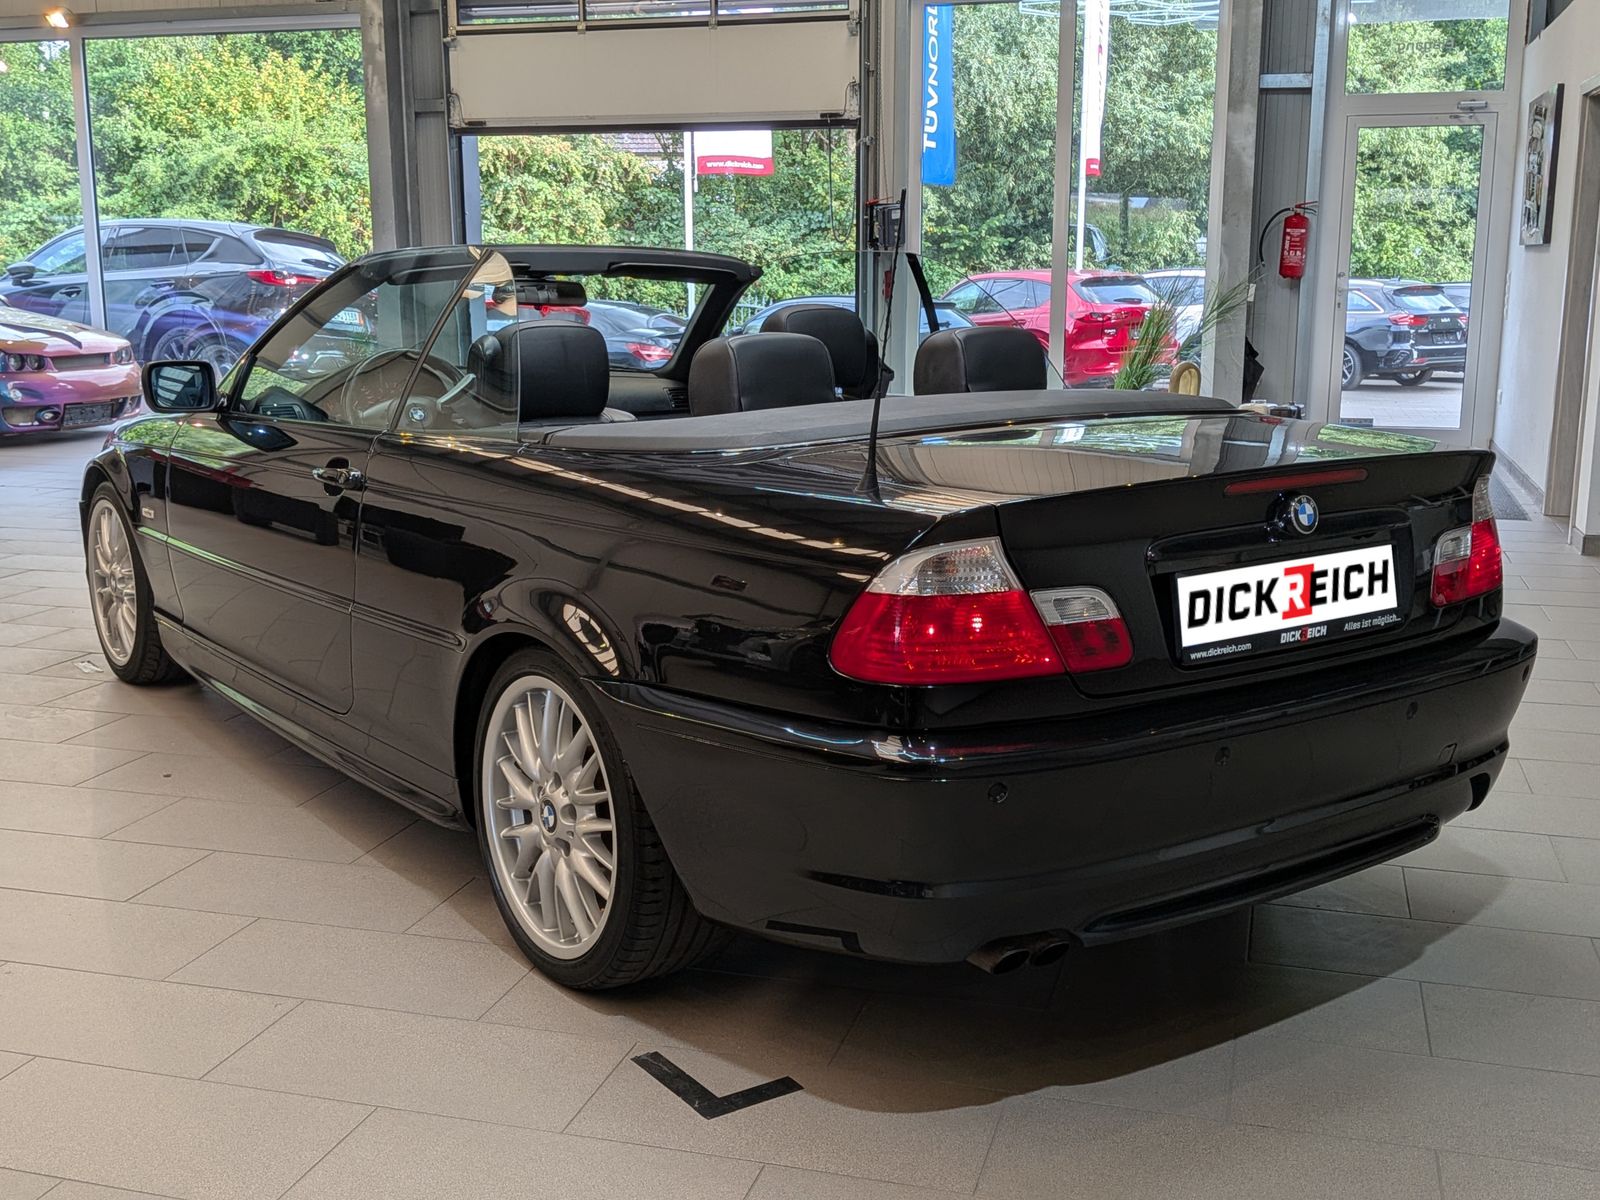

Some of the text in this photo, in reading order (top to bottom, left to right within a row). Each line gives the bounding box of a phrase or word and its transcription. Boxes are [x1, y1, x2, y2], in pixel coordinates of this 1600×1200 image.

[1187, 559, 1390, 629] DICKREICH
[1343, 621, 1361, 631] Alles
[1361, 618, 1371, 628] ist
[1190, 643, 1252, 660] www.dickreich.com
